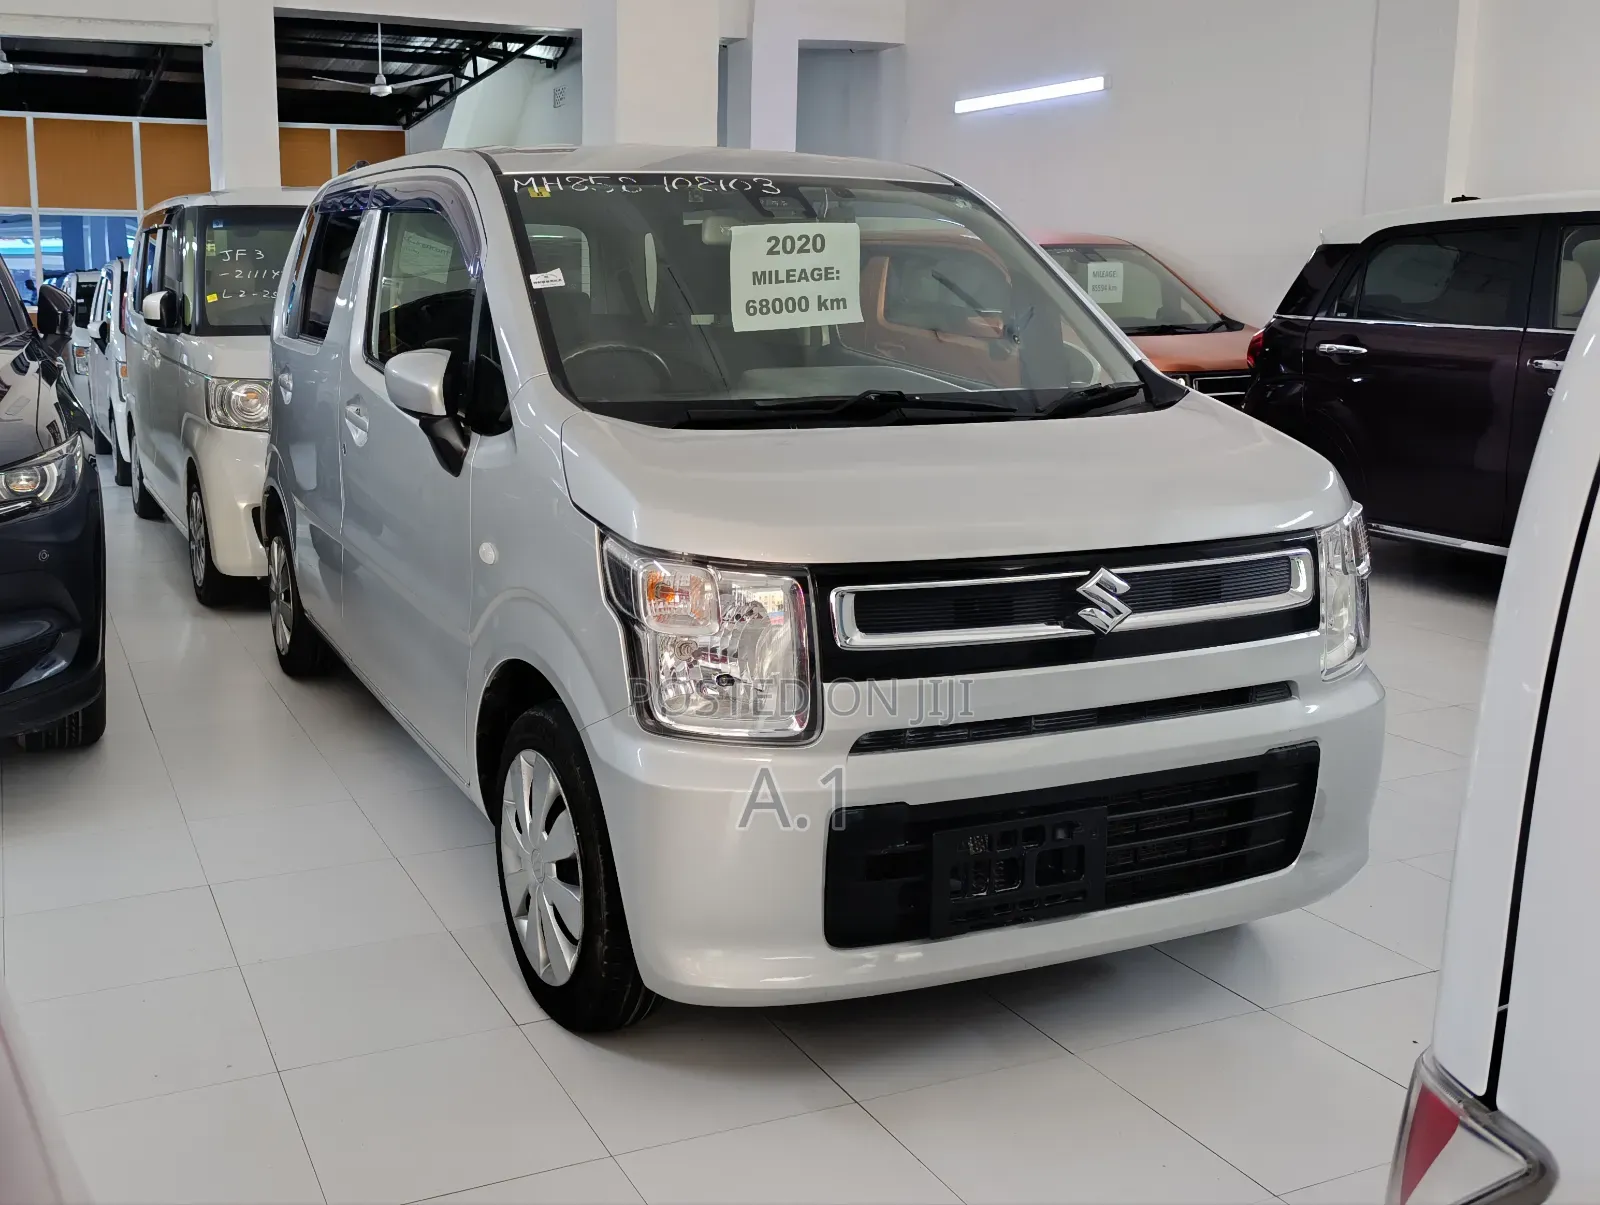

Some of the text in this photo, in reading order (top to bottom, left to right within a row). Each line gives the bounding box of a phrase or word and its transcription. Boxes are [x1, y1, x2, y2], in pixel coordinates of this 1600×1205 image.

[766, 233, 826, 256] 2020
[751, 266, 841, 286] MILEAGE:
[745, 295, 848, 317] 68000 km
